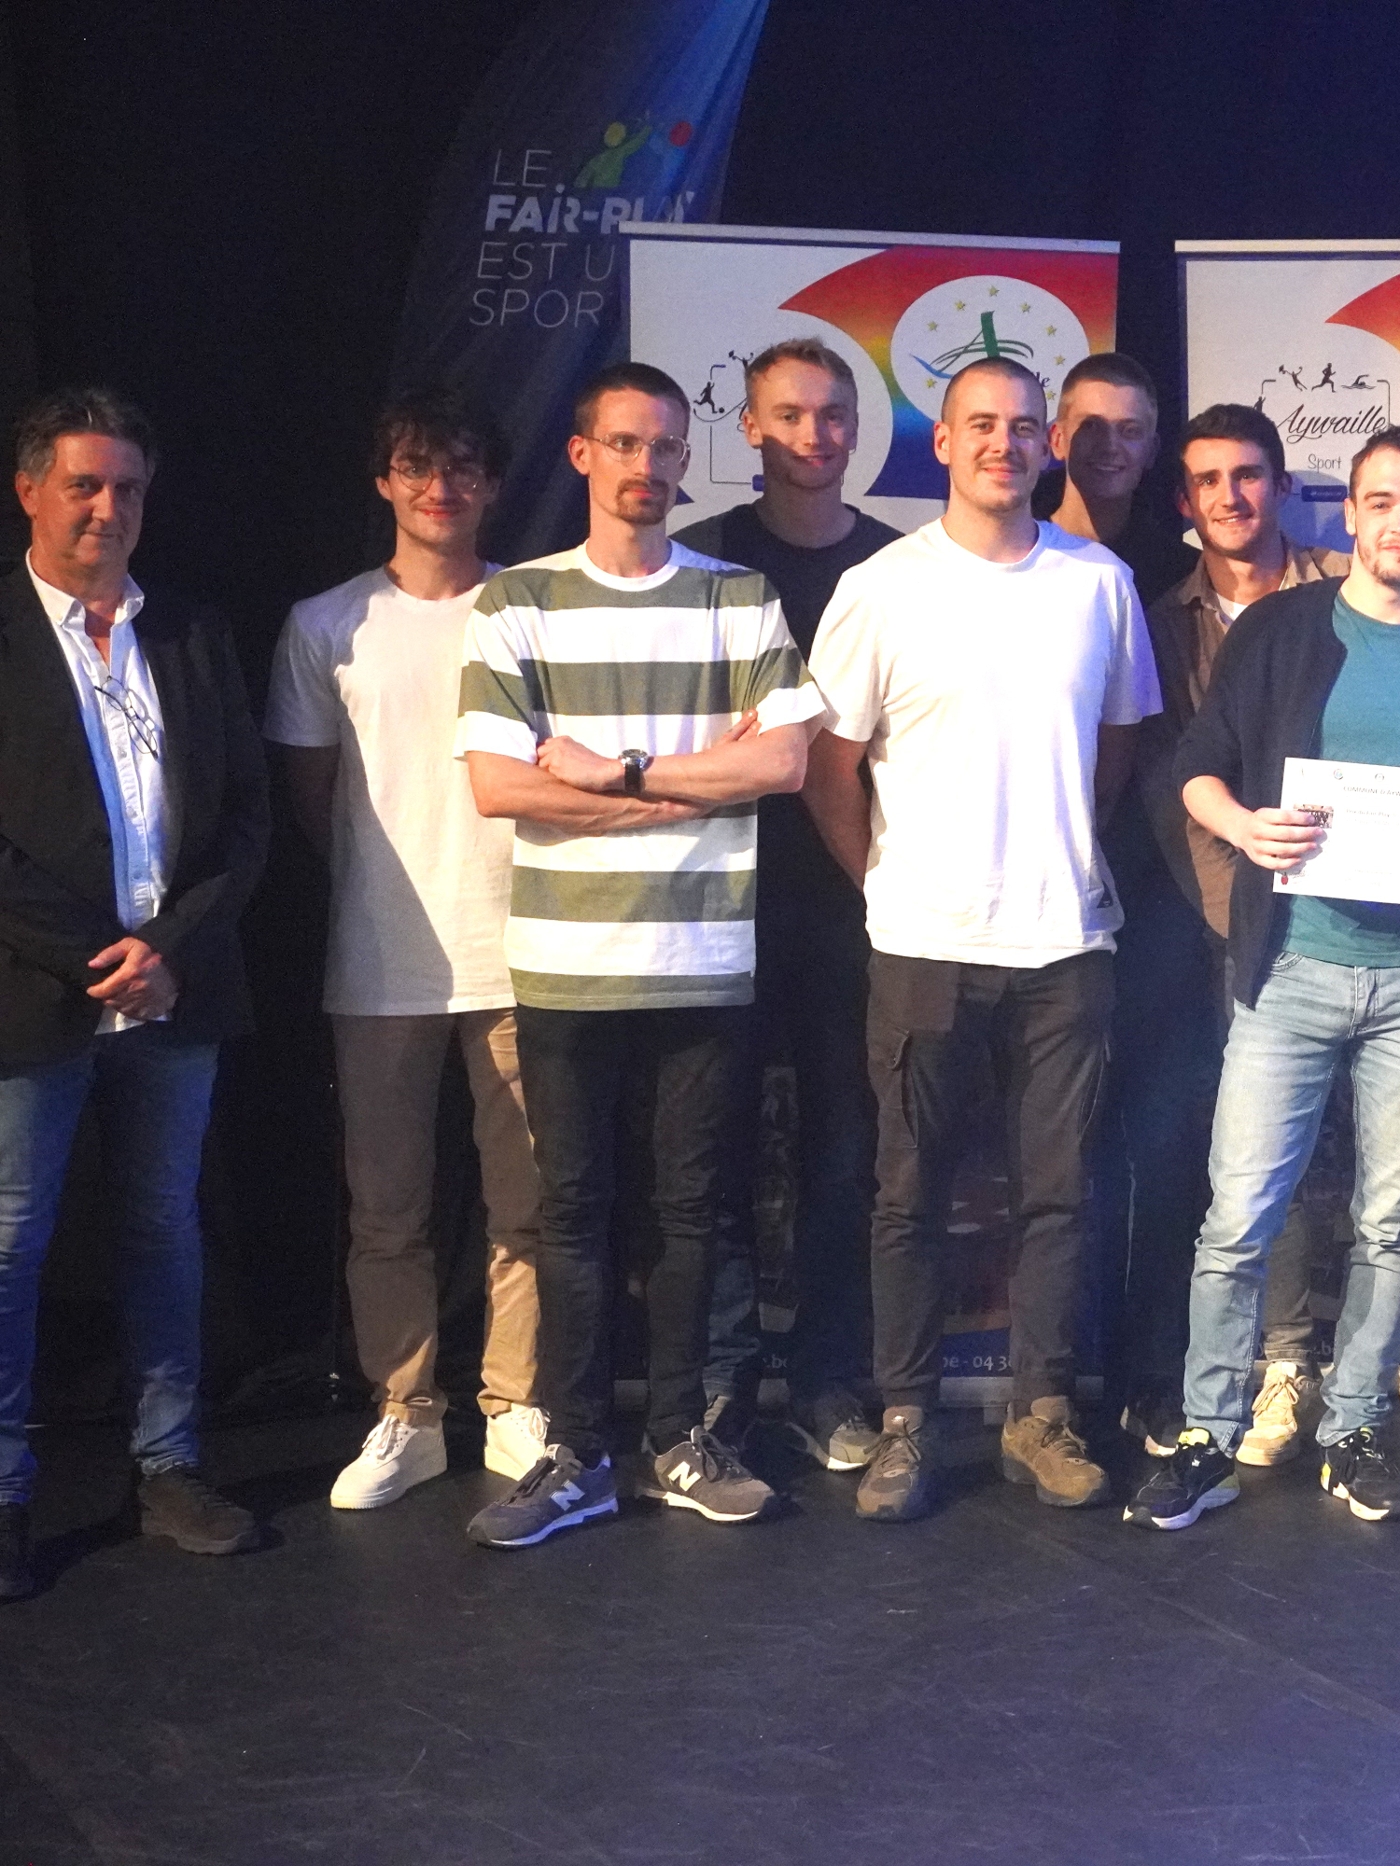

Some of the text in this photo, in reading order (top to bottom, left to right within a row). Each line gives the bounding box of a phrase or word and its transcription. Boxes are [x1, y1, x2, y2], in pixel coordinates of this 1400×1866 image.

[493, 149, 551, 187] LE
[477, 241, 616, 281] EST U
[468, 287, 605, 328] SPOR
[1276, 403, 1388, 444] Aywaille
[1307, 453, 1342, 474] Sport
[972, 1354, 995, 1371] 04
[668, 1460, 702, 1492] N
[549, 1478, 586, 1512] N
